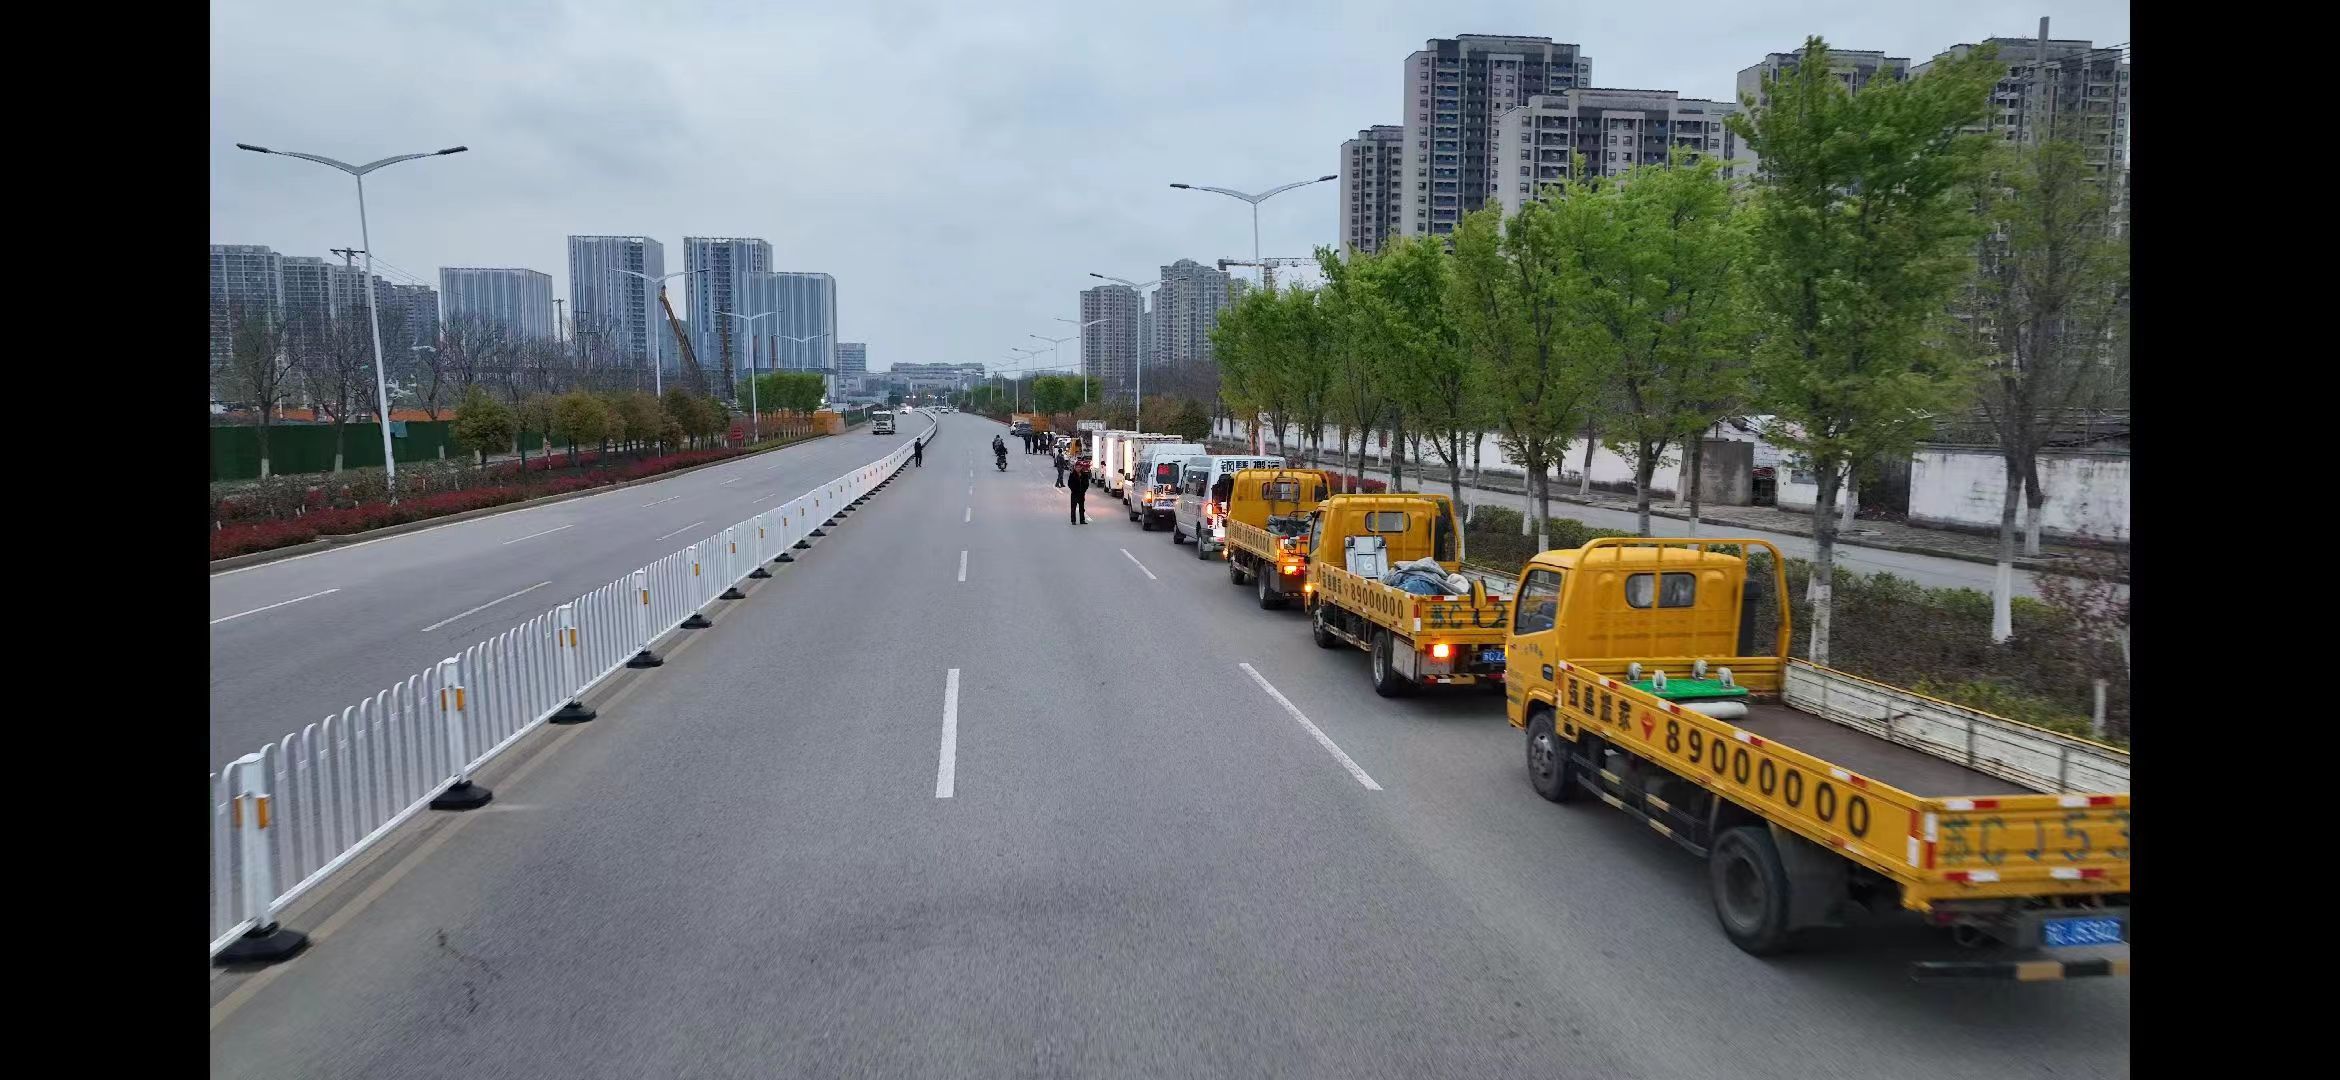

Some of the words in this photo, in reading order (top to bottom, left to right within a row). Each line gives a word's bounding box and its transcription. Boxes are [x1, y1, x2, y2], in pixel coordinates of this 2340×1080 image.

[1350, 583, 1404, 619] 89000000
[1568, 678, 1632, 732] 强盛搬家
[1666, 720, 1870, 838] 89000000
